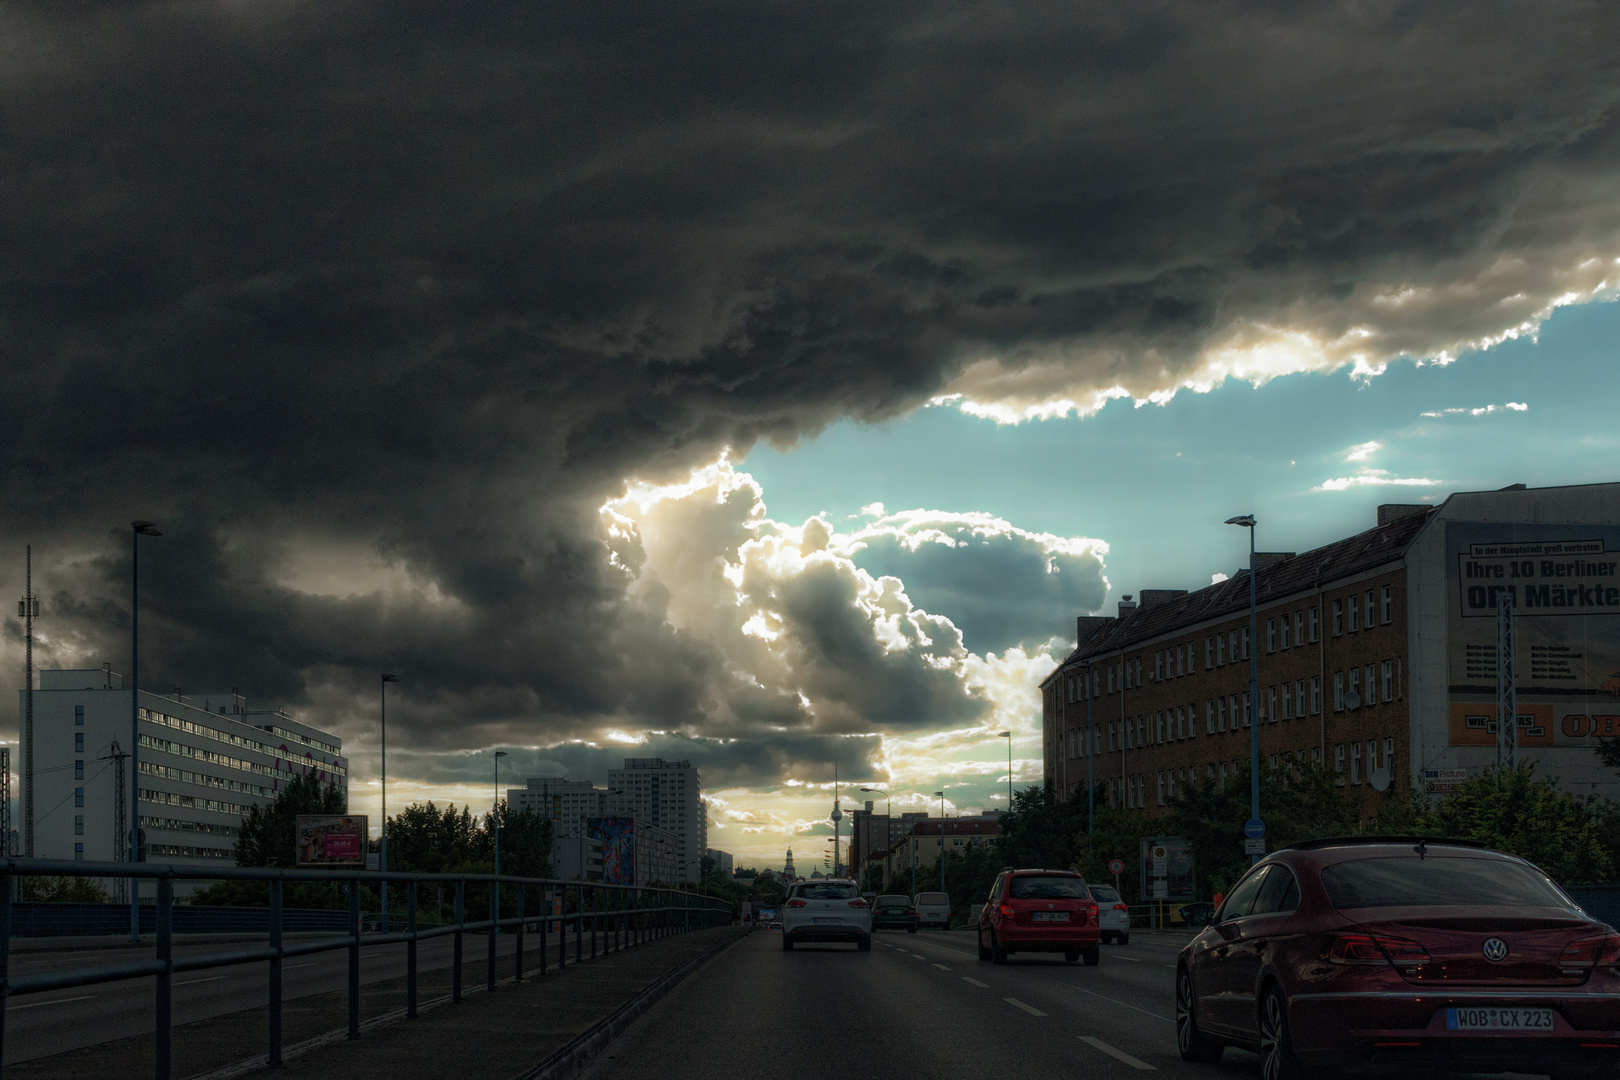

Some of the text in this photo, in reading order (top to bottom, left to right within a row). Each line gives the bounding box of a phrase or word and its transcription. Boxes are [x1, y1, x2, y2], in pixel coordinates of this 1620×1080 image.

[1485, 546, 1498, 554] der
[1500, 545, 1542, 555] Hauptstadt
[1544, 544, 1562, 555] groß
[1564, 543, 1600, 552] vertreten
[1466, 559, 1617, 578] Ihre 10 Berliner
[1525, 583, 1620, 608] Märkte
[1468, 718, 1486, 726] WIE
[1440, 769, 1466, 778] Picture
[1458, 1010, 1488, 1027] WOB
[1500, 1010, 1520, 1027] CX
[1523, 1010, 1552, 1027] 223
